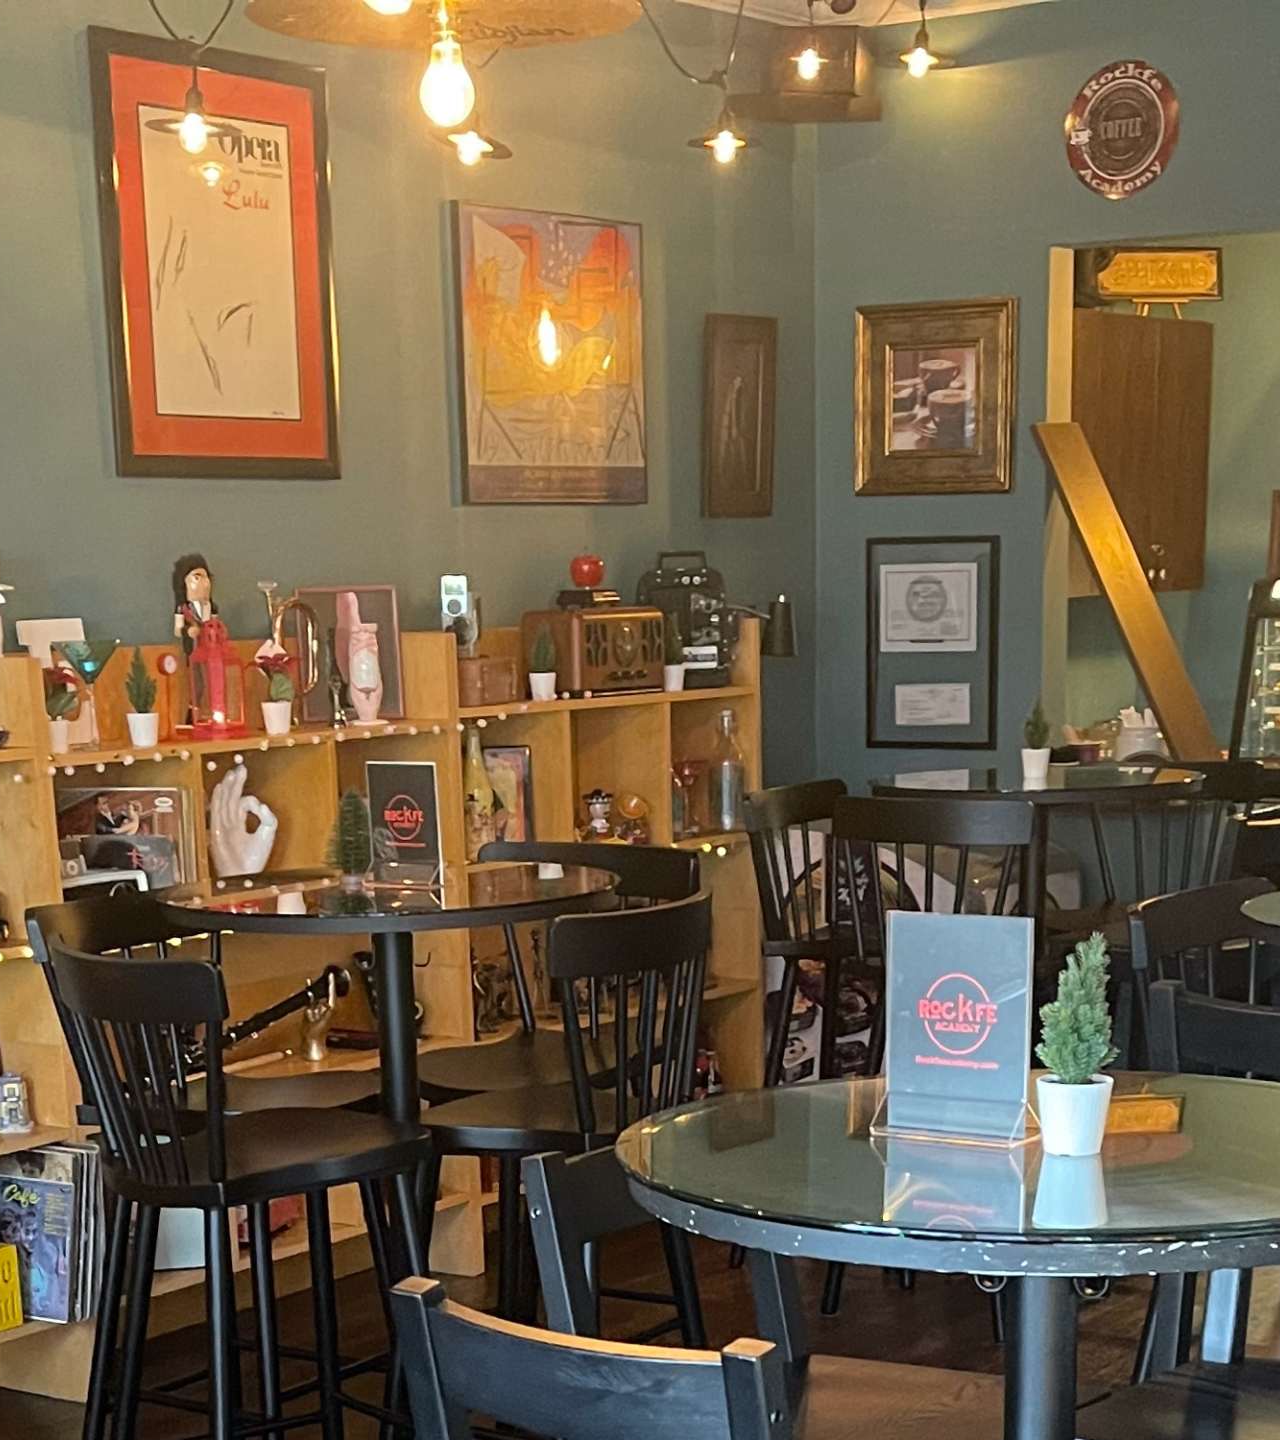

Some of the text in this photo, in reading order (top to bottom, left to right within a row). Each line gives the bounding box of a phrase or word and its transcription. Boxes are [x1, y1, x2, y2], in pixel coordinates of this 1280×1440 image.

[1082, 63, 1162, 98] Rockfe
[1079, 160, 1162, 193] Academy
[222, 179, 269, 210] Lulu
